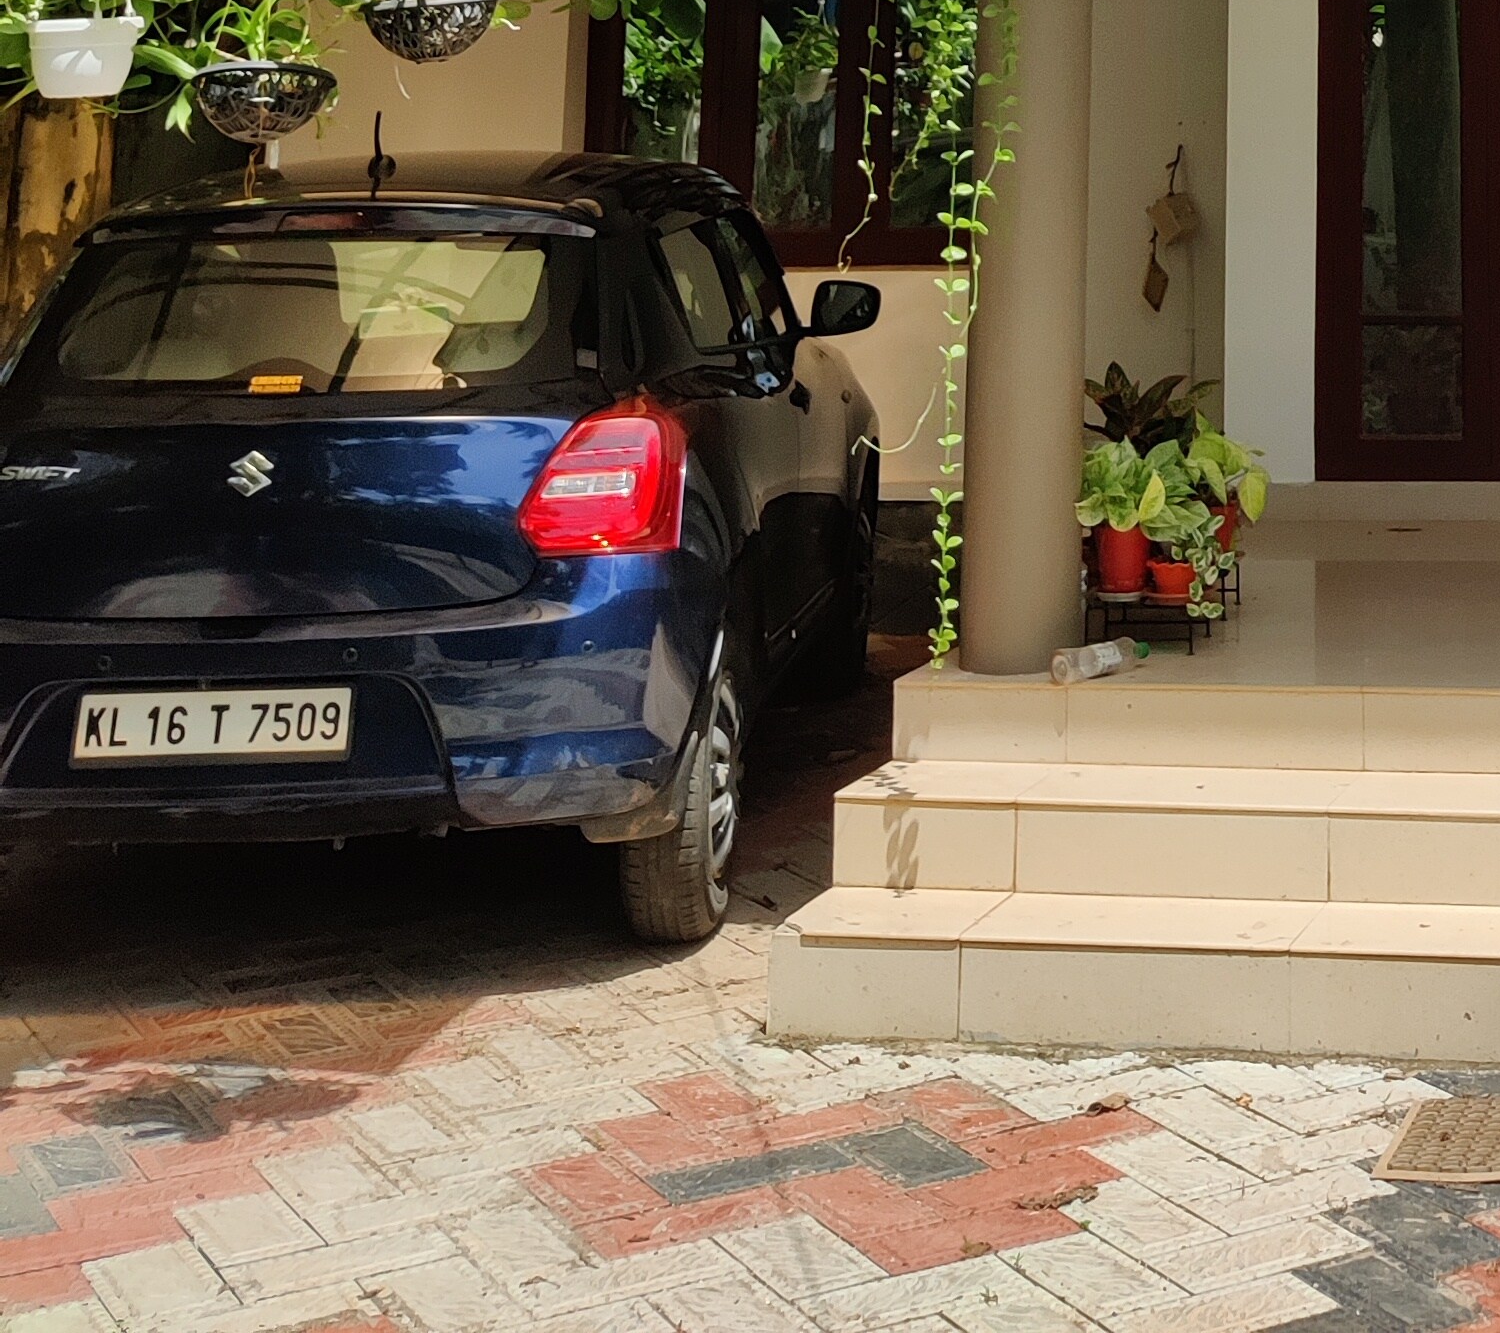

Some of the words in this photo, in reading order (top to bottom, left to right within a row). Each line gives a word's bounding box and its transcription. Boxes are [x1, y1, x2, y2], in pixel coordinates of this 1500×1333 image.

[0, 465, 82, 481] SWIFT
[84, 707, 127, 748] KL
[147, 705, 189, 746] 16
[210, 704, 231, 745] T
[248, 701, 341, 743] 7509
